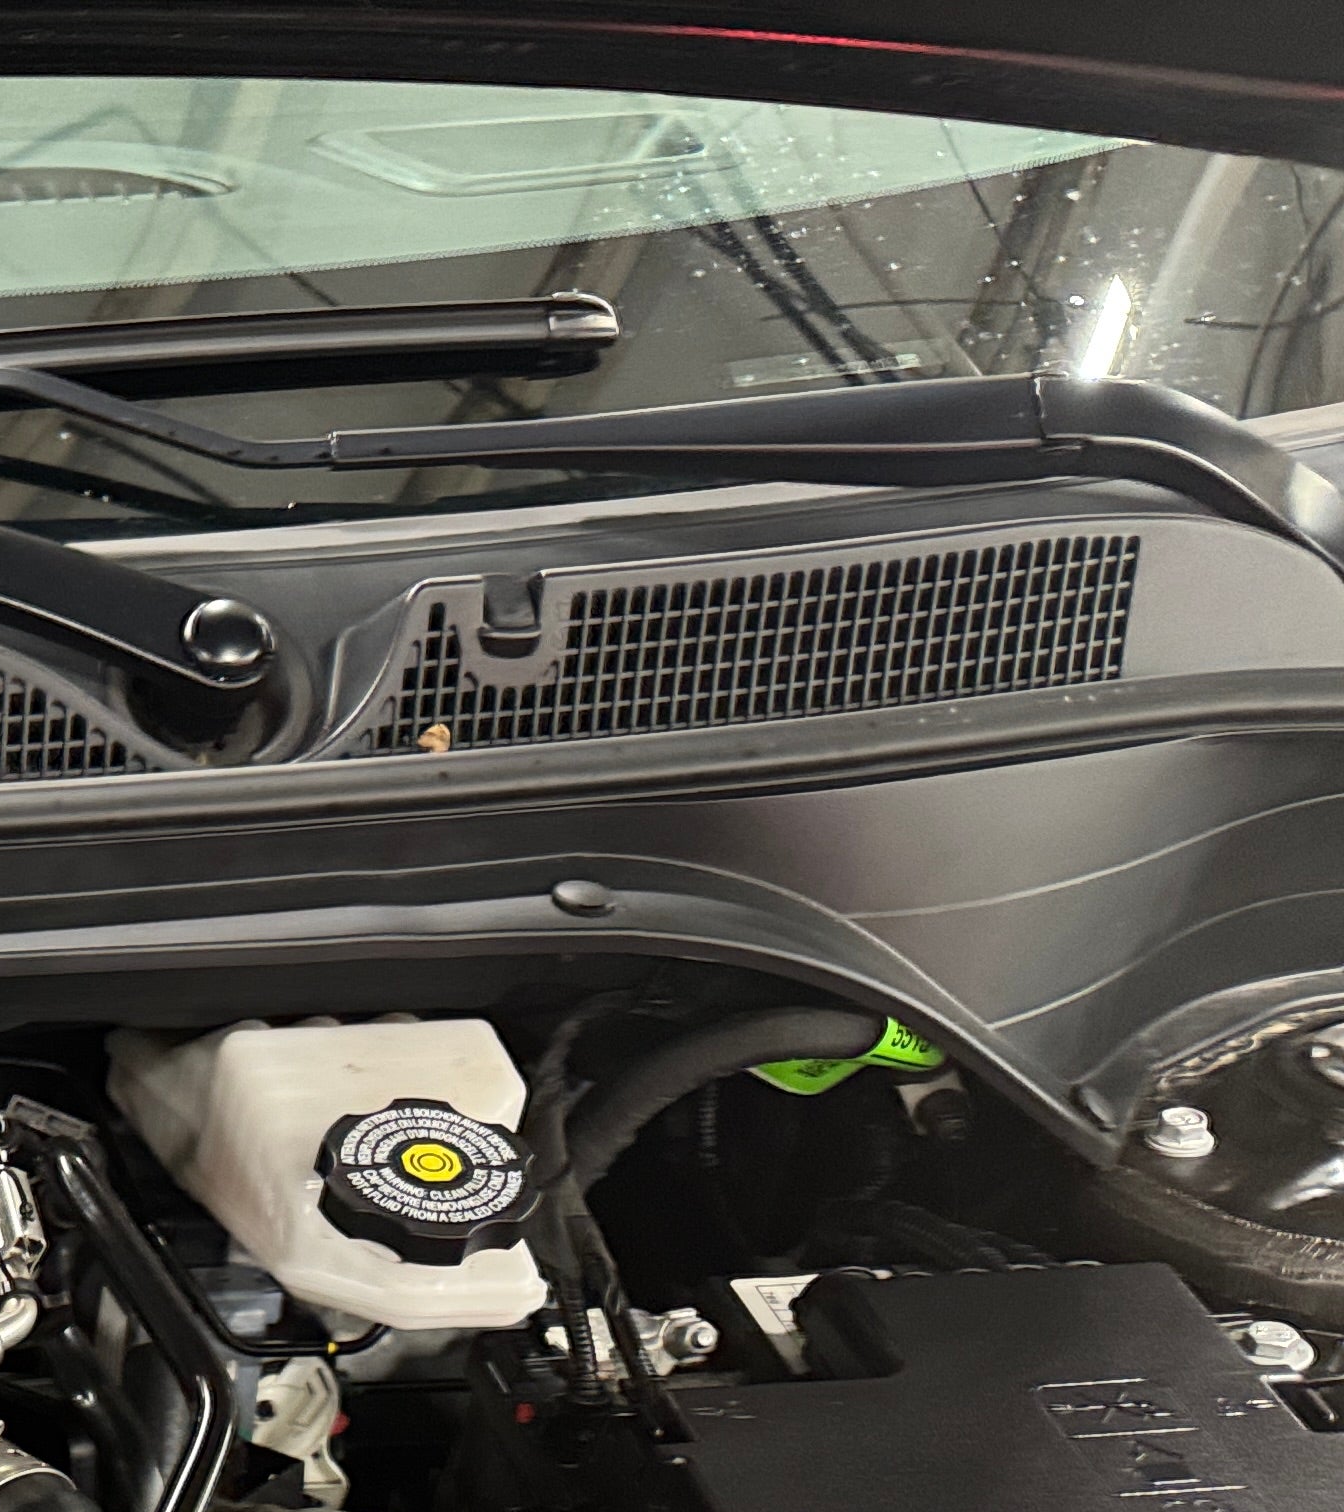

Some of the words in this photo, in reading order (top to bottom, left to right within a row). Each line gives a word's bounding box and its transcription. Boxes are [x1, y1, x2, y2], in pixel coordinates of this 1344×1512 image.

[398, 1108, 413, 1118] LE
[413, 1108, 462, 1124] BOUCHON
[458, 1118, 493, 1137] AVANT
[449, 1124, 466, 1136] DE
[363, 1170, 385, 1185] CAP
[378, 1184, 421, 1208] BEFORE
[430, 1188, 469, 1201] CLEAN
[367, 1191, 402, 1212] FLUID
[401, 1206, 438, 1221] FROM
[438, 1212, 449, 1223] A
[448, 1206, 493, 1223] SEALED
